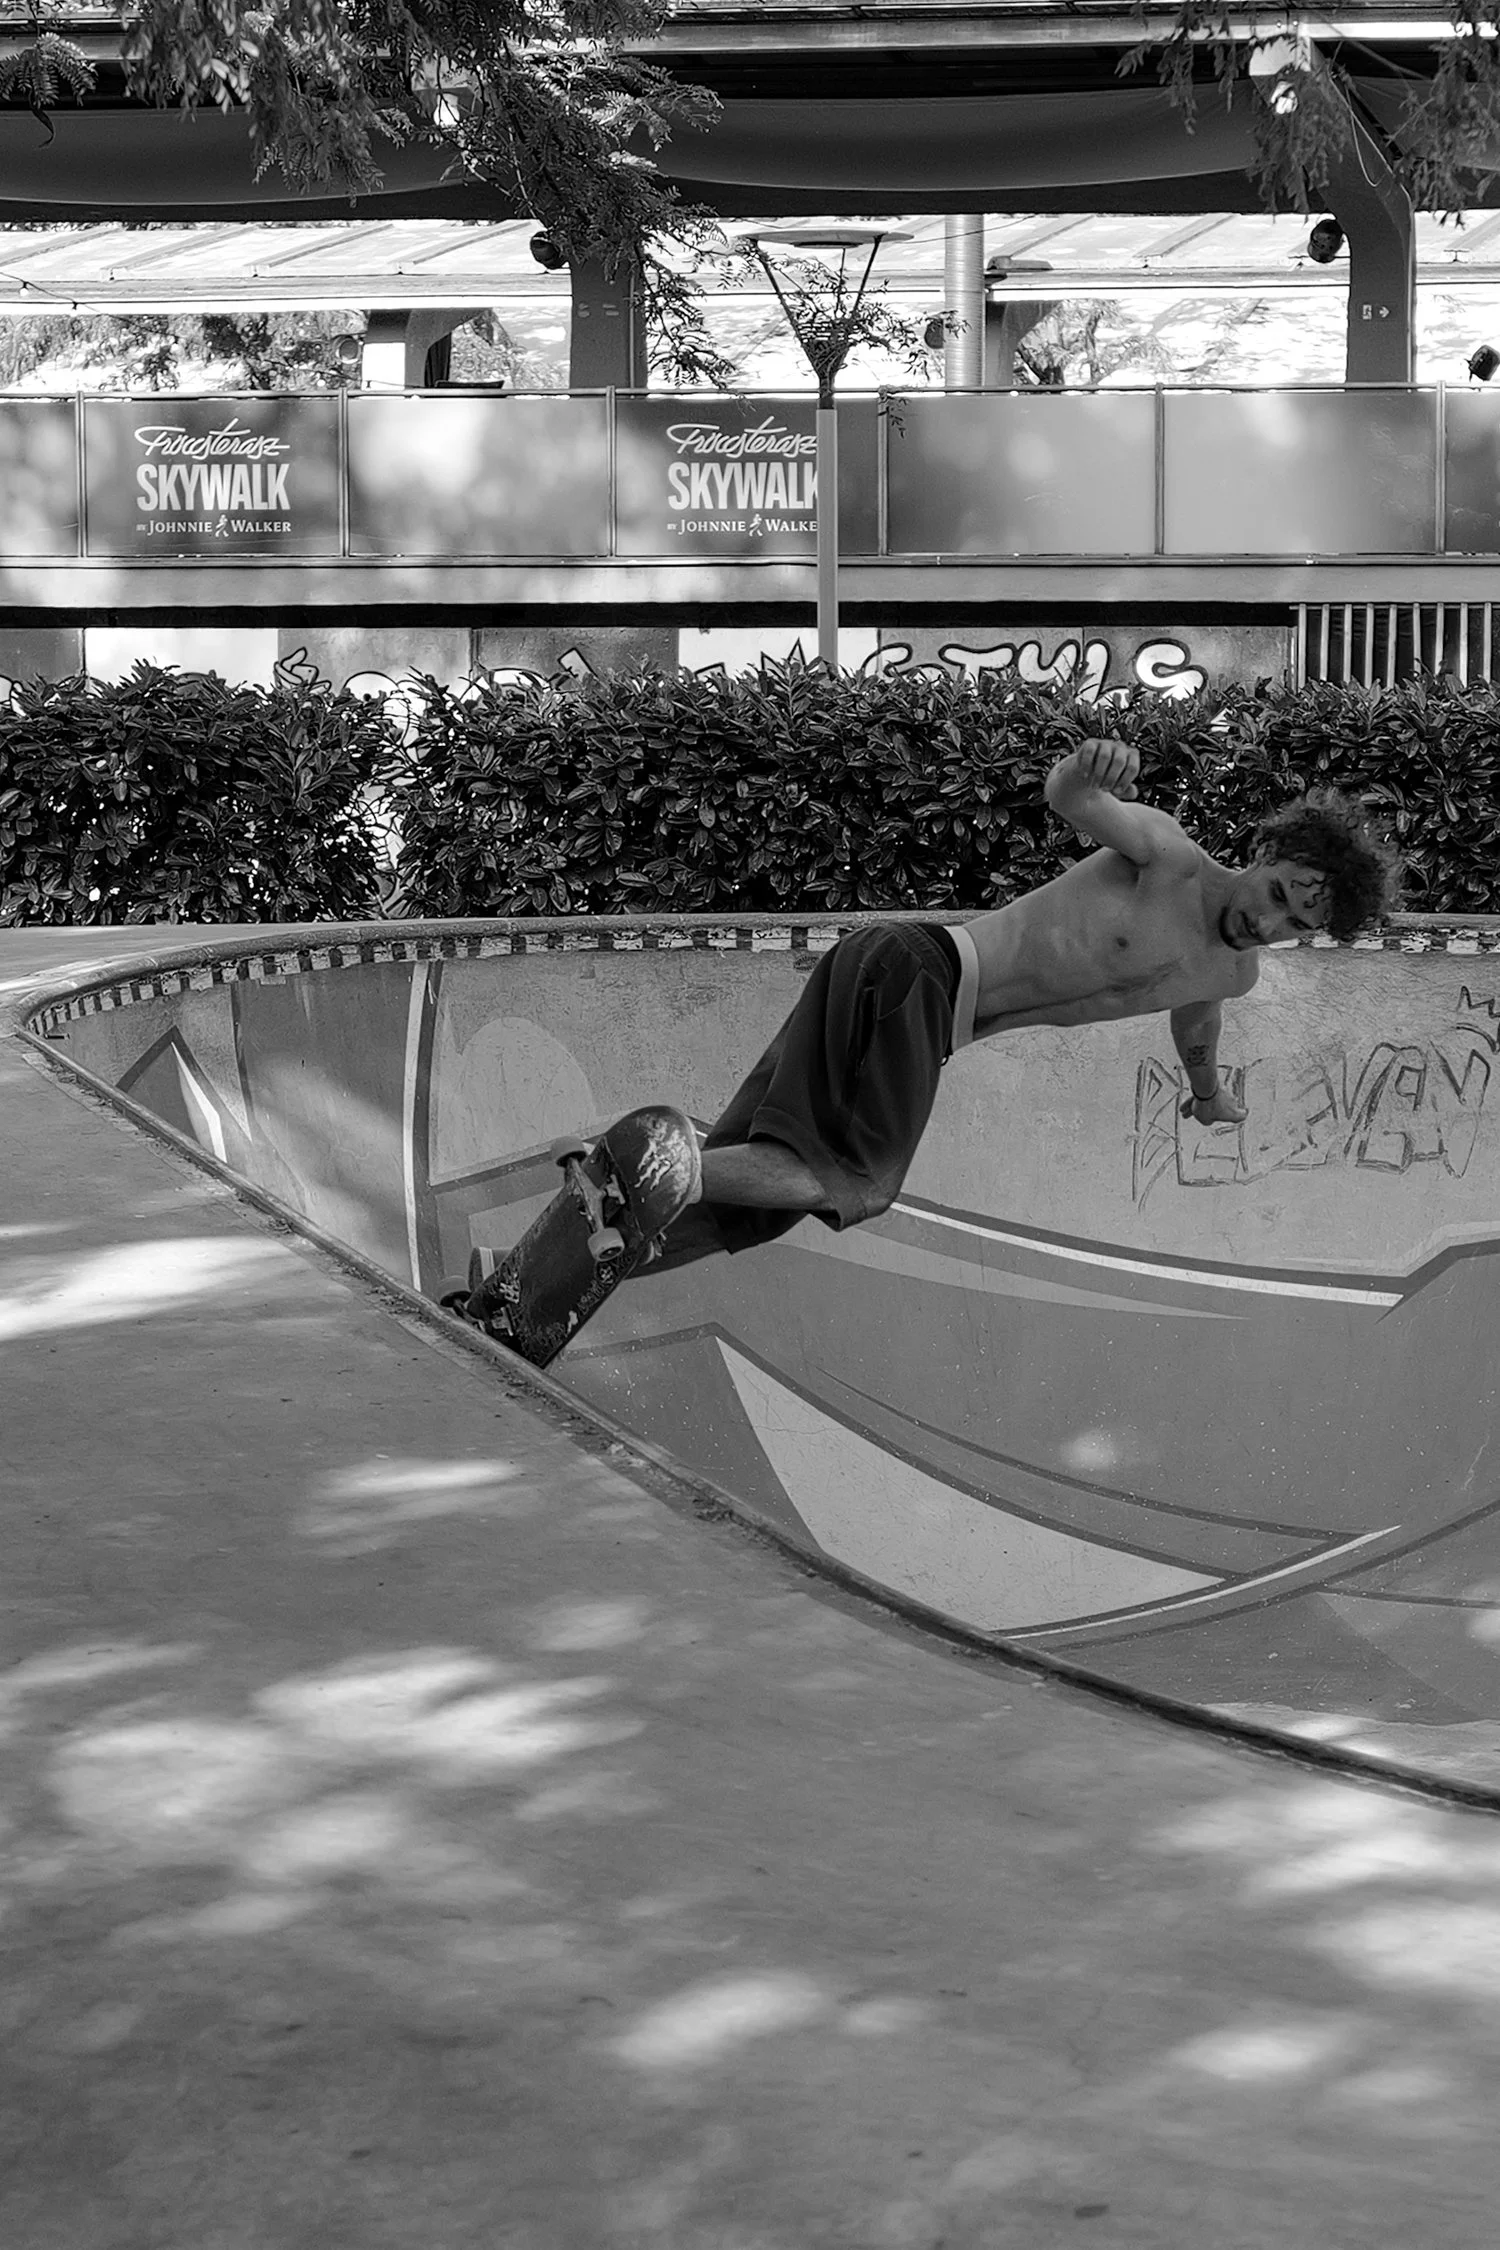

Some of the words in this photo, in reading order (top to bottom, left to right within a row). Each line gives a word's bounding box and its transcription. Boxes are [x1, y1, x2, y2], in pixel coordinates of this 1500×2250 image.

[136, 463, 291, 512] SKYWALK
[667, 462, 818, 510] SKYWALK
[147, 519, 213, 536] JOHNNIE
[230, 519, 292, 533] WALKER
[678, 518, 747, 535] JOHNNIE
[764, 518, 818, 532] WALKE
